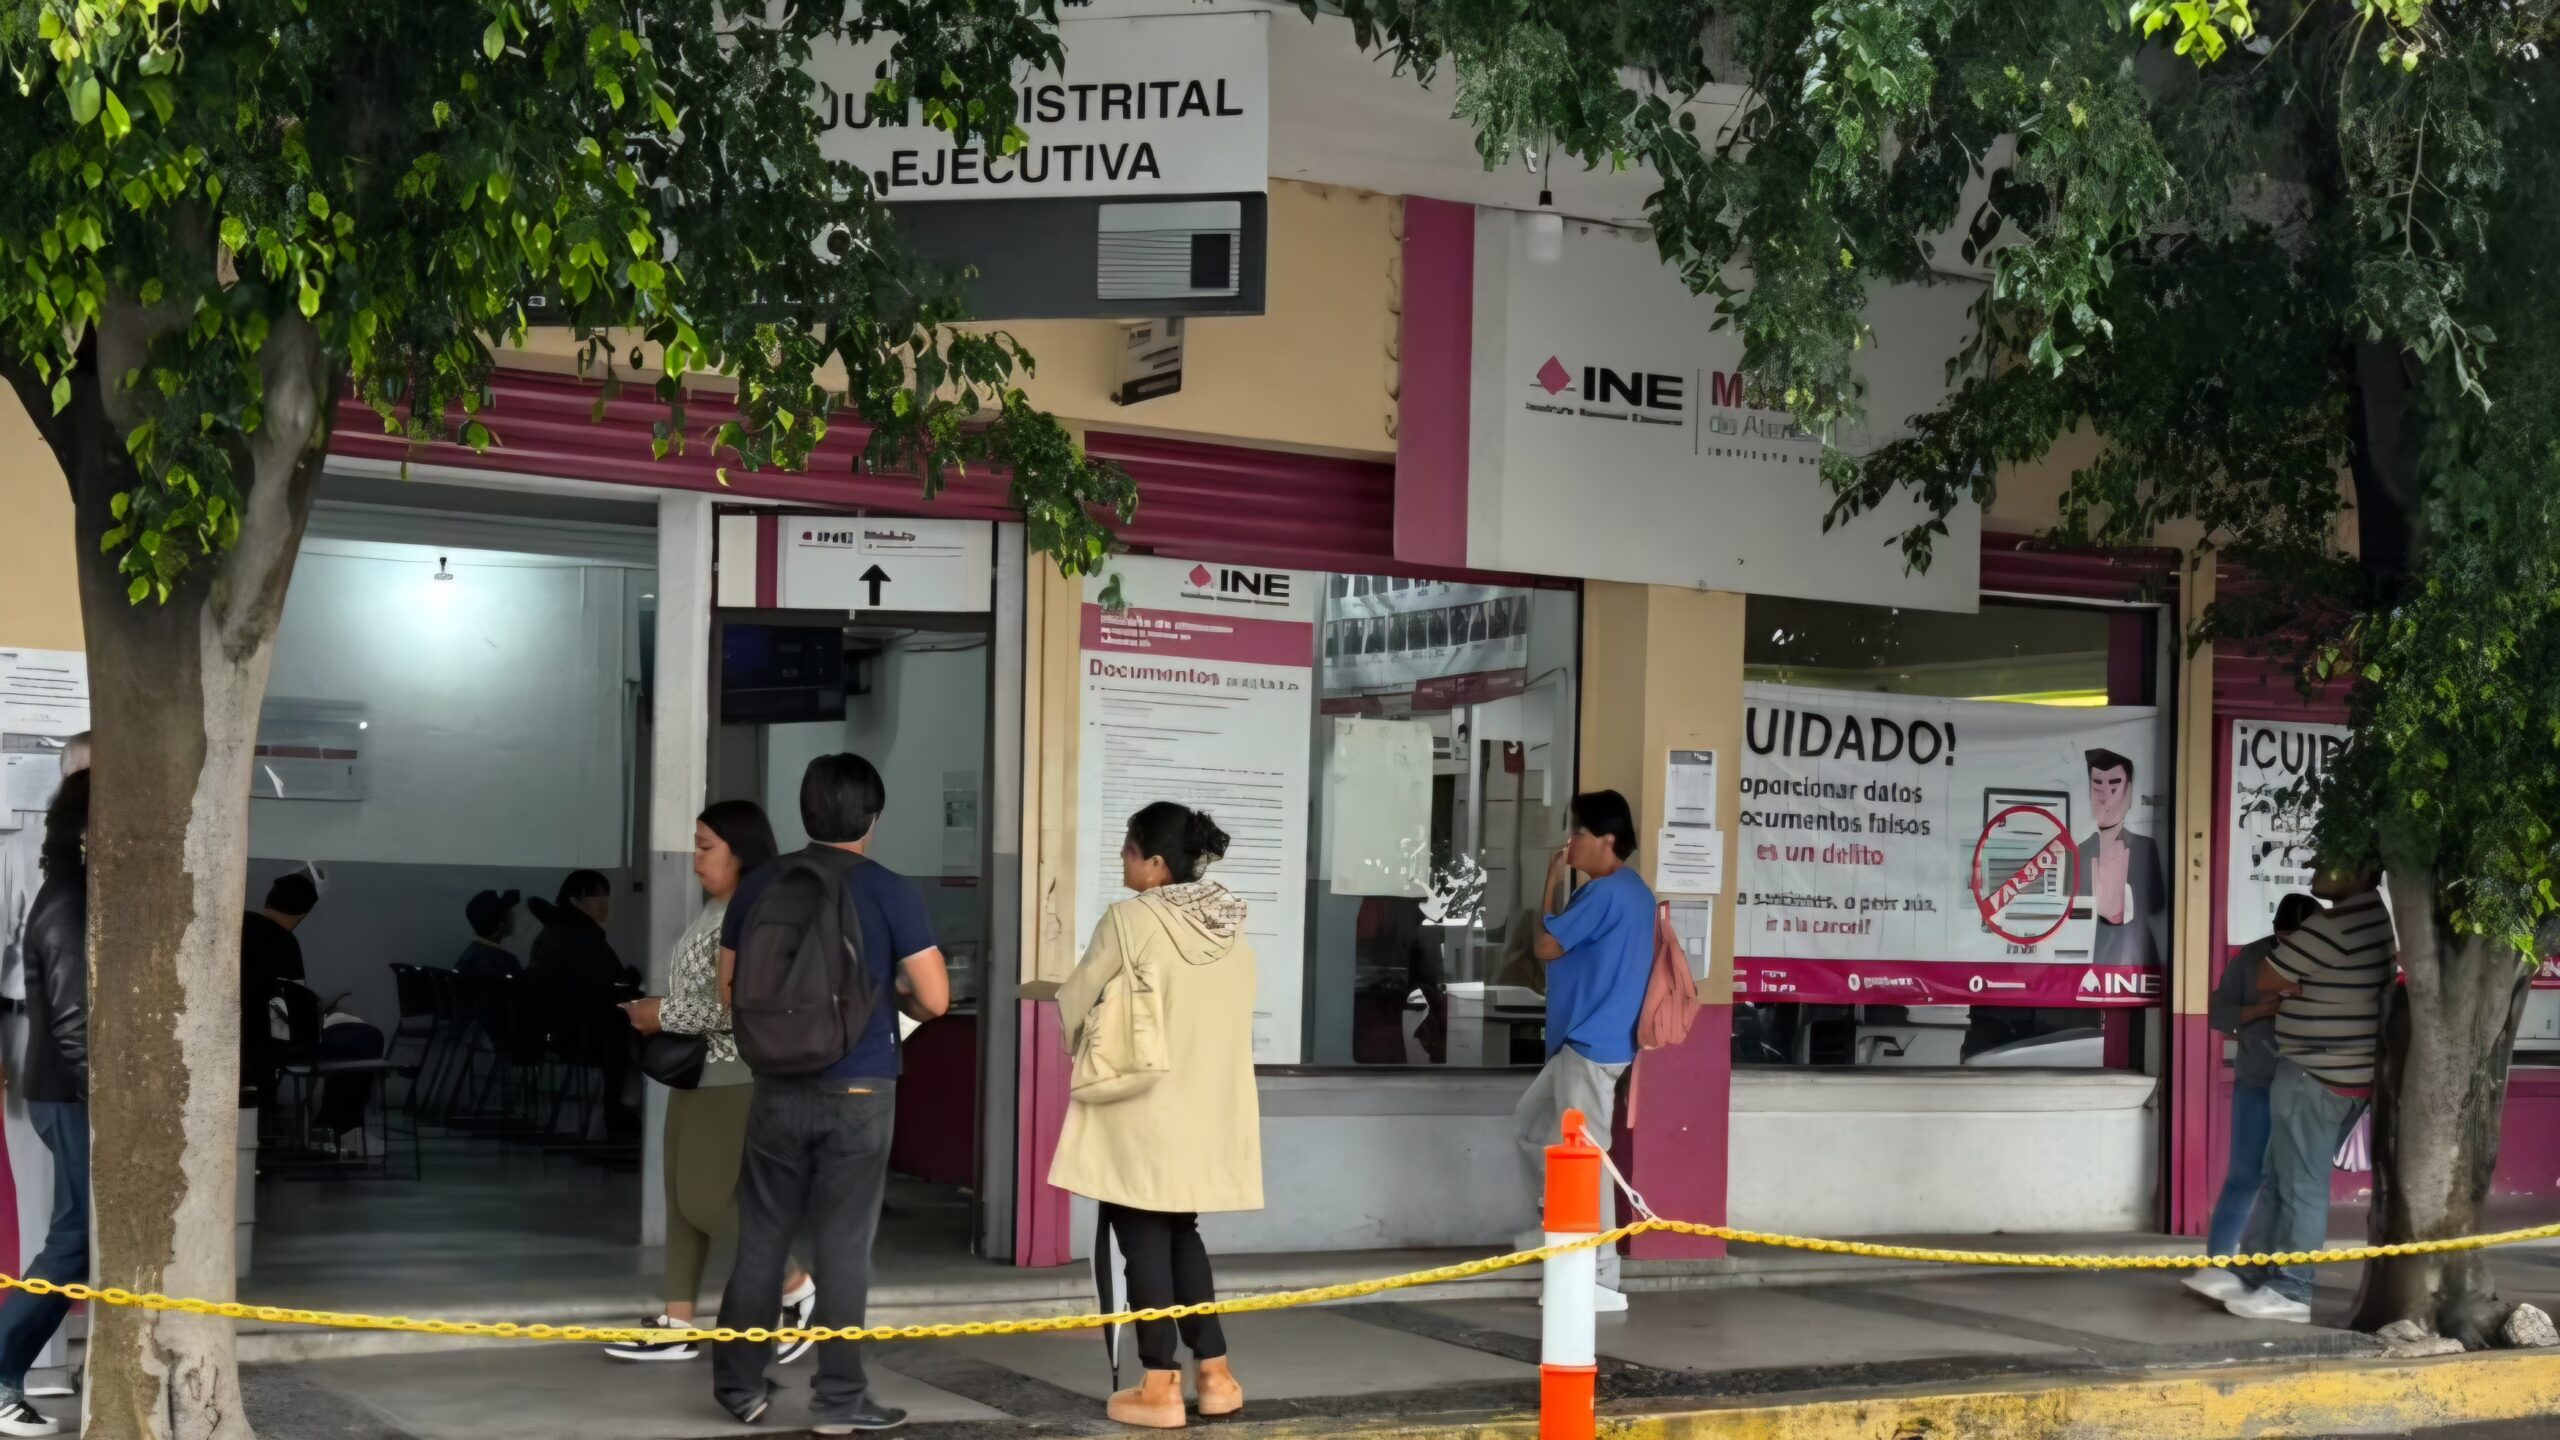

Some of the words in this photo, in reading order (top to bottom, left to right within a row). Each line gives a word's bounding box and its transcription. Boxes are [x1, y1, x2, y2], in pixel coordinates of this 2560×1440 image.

[1022, 78, 1244, 124] ISTRITAL
[891, 142, 1161, 186] EJECUTIVA
[1584, 366, 1683, 411] INE
[1220, 569, 1290, 598] INE
[1745, 706, 1957, 767] UIDADO!
[1739, 776, 1858, 800] oporcionar
[1739, 810, 1862, 834] ocumentos
[1785, 845, 1815, 862] un
[2105, 972, 2161, 994] INE
